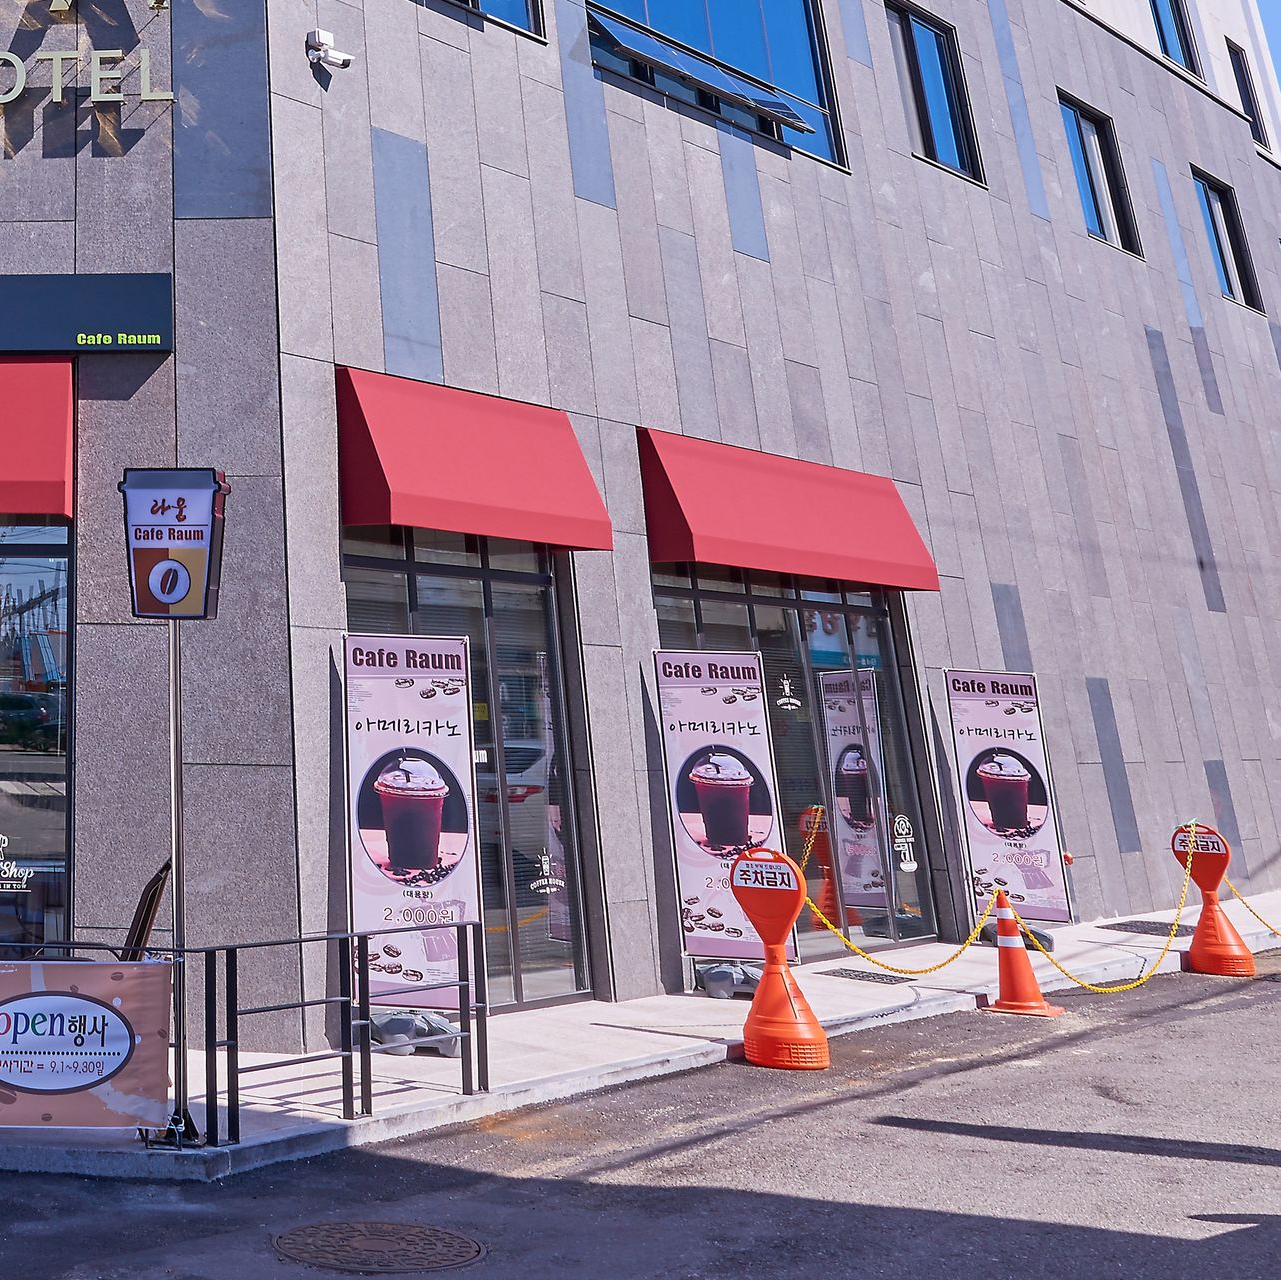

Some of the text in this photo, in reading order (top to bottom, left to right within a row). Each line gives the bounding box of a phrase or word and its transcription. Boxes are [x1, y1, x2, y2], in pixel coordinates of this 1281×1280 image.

[77, 333, 161, 345] Cafe Raum
[150, 497, 187, 522] 라움
[134, 527, 204, 541] Cafe Raum
[352, 647, 462, 670] Cafe Raum
[662, 662, 758, 680] Cafe Raum
[951, 678, 1033, 696] Cafe Raum
[355, 717, 462, 737] 아메리카노
[669, 720, 761, 736] 아메리카노
[959, 726, 1037, 741] 아메리카노
[992, 852, 1044, 867] 2.000원
[0, 860, 35, 885] Shop
[739, 869, 792, 888] 주차금지
[402, 890, 434, 899] (대용량)
[383, 907, 454, 925] 2.000원
